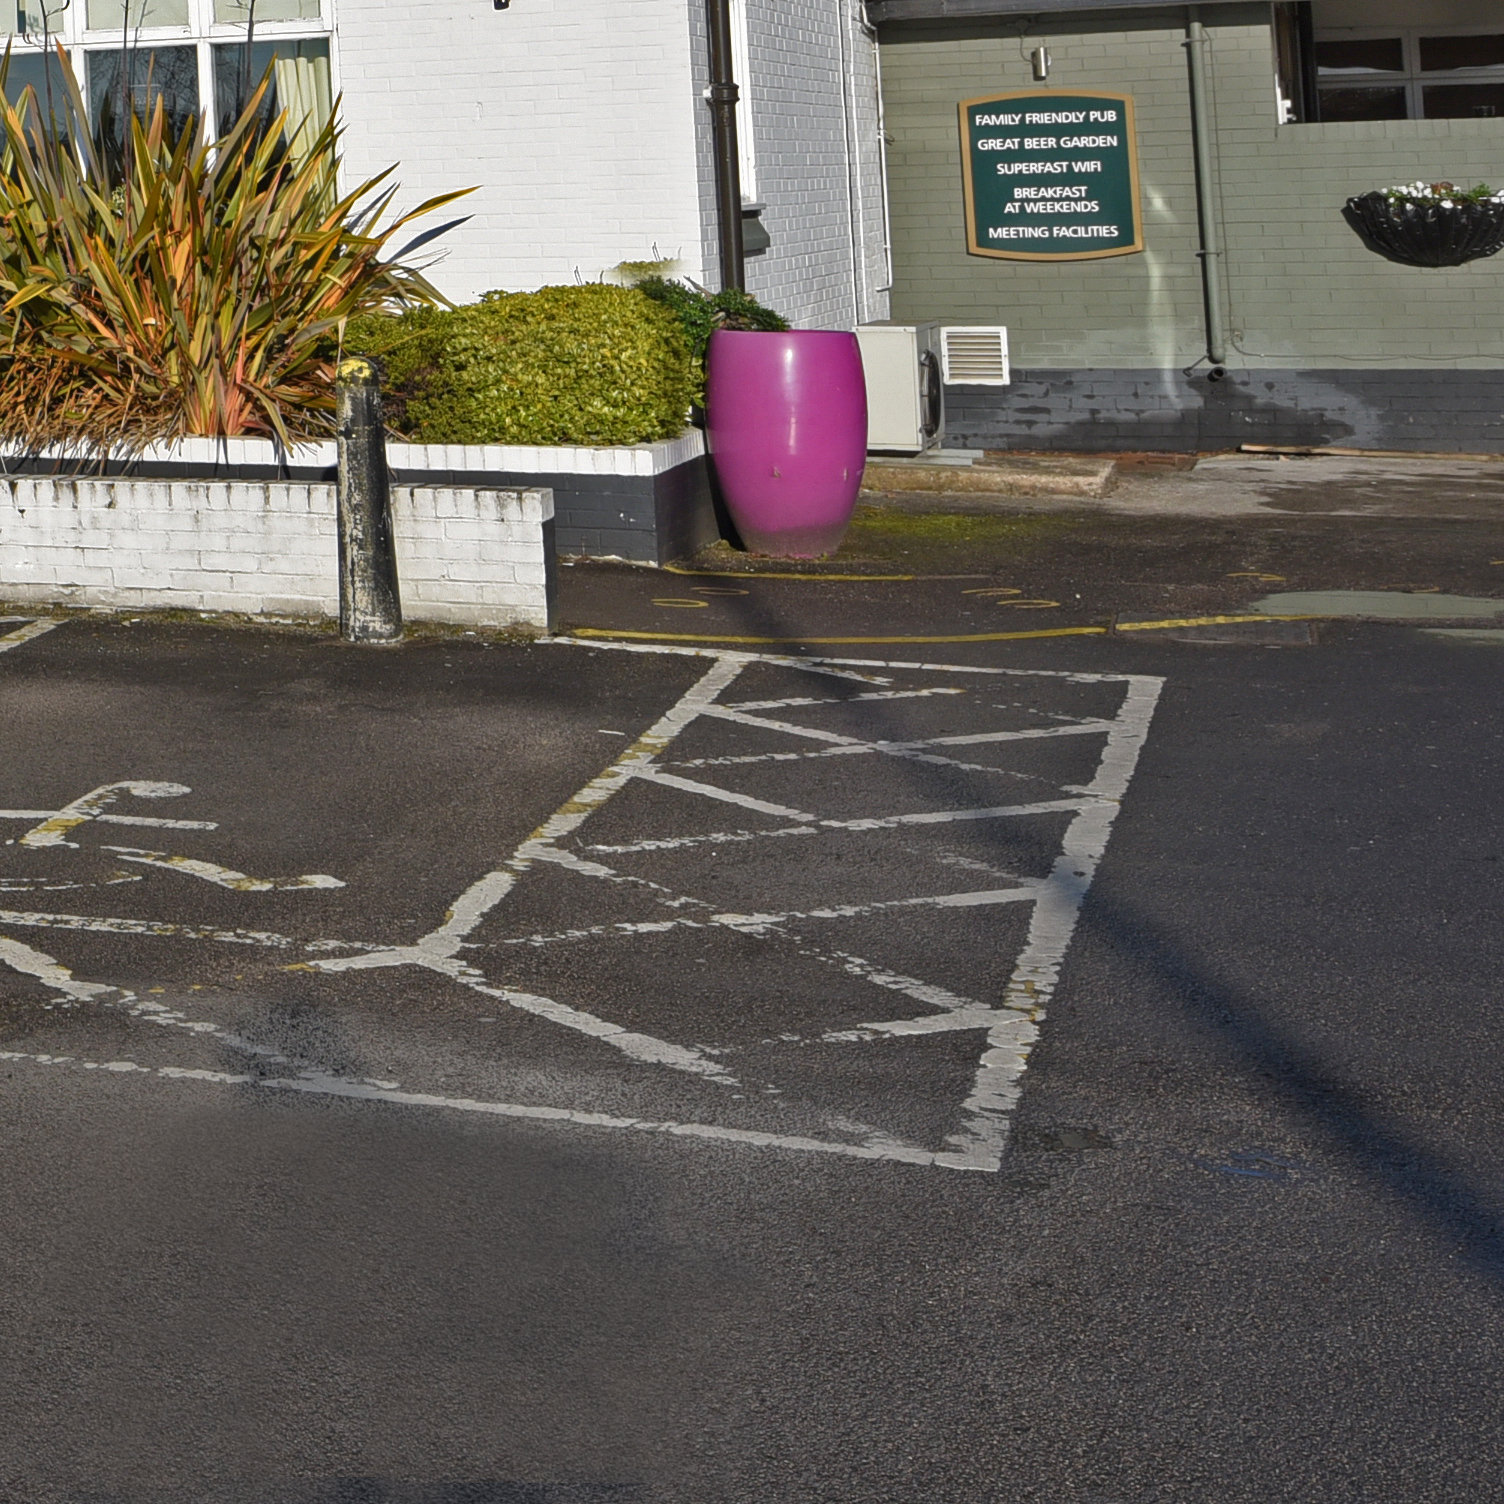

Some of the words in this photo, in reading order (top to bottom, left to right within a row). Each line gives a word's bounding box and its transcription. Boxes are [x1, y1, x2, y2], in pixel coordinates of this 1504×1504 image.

[975, 113, 1022, 126] FAMILY
[1025, 111, 1086, 124] FRIENDLY
[1089, 110, 1117, 123] PUB
[977, 138, 1020, 150] GREAT
[1024, 137, 1057, 149] BEER
[1060, 136, 1118, 148] GARDEN
[996, 161, 1069, 175] SUPERFAST
[1071, 161, 1101, 172] WIFI
[1014, 186, 1088, 199] BREAKFAST
[1004, 202, 1021, 214] AT
[1024, 200, 1099, 213] WEEKENDS
[988, 226, 1049, 239] MEETING
[1053, 225, 1119, 238] FACILITIES
